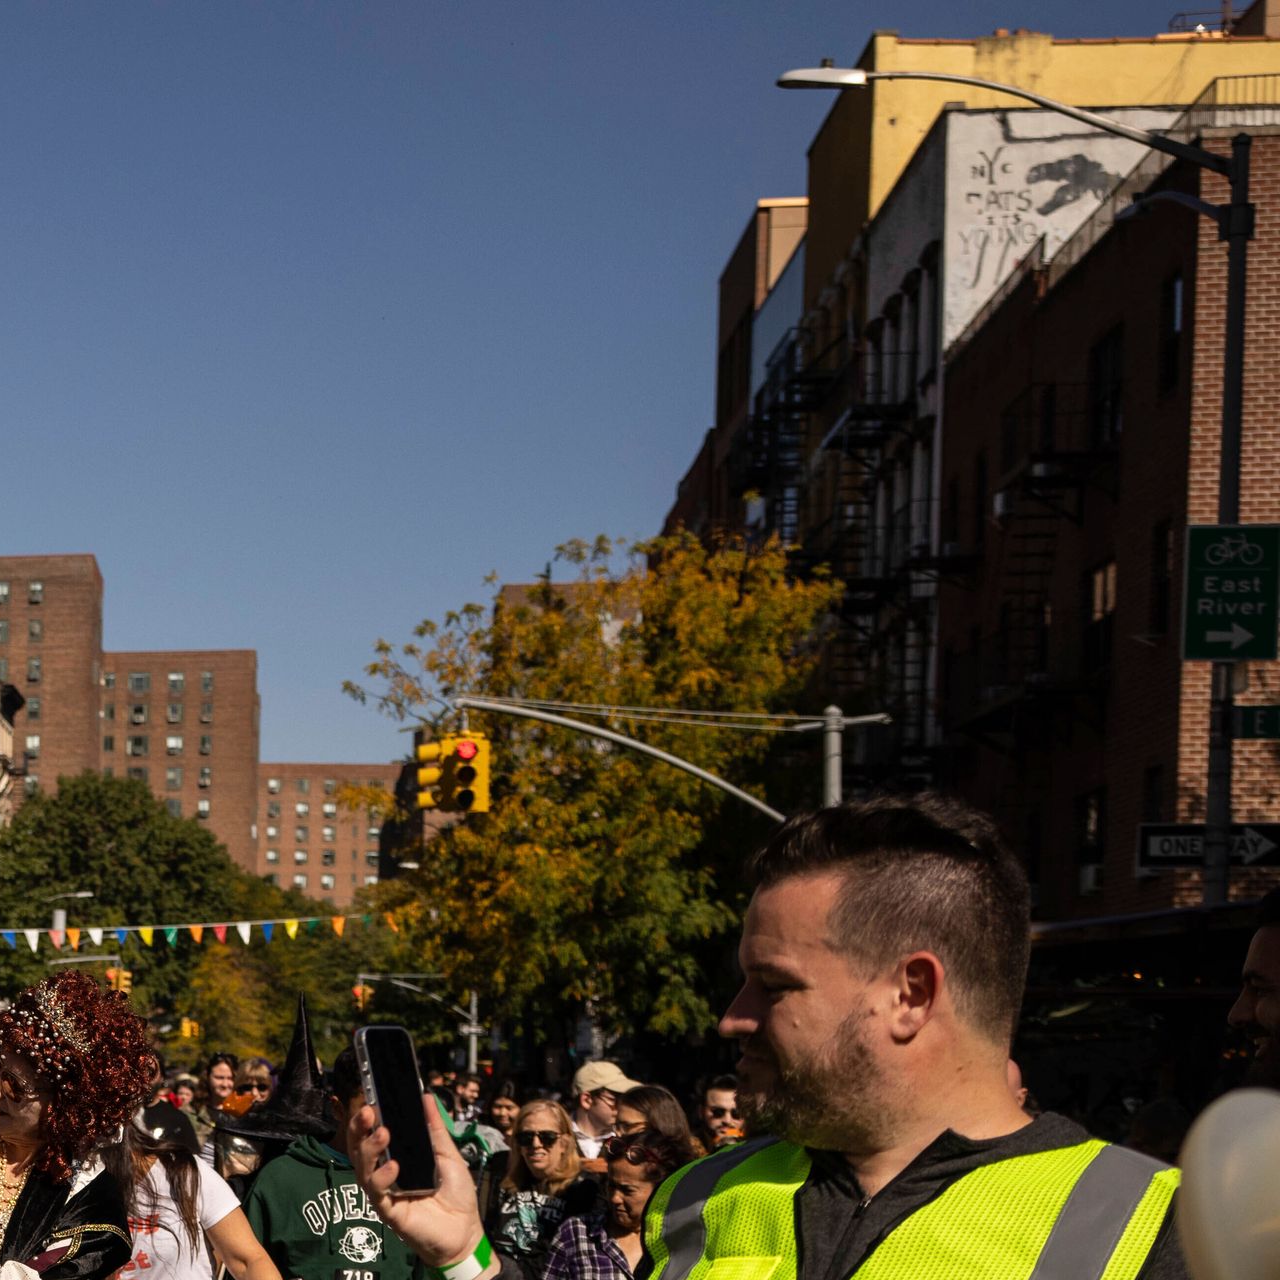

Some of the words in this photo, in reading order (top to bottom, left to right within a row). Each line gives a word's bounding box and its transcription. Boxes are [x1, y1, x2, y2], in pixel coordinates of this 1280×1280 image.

[1203, 575, 1263, 594] East
[1197, 597, 1268, 616] River
[1160, 839, 1200, 855] ONE
